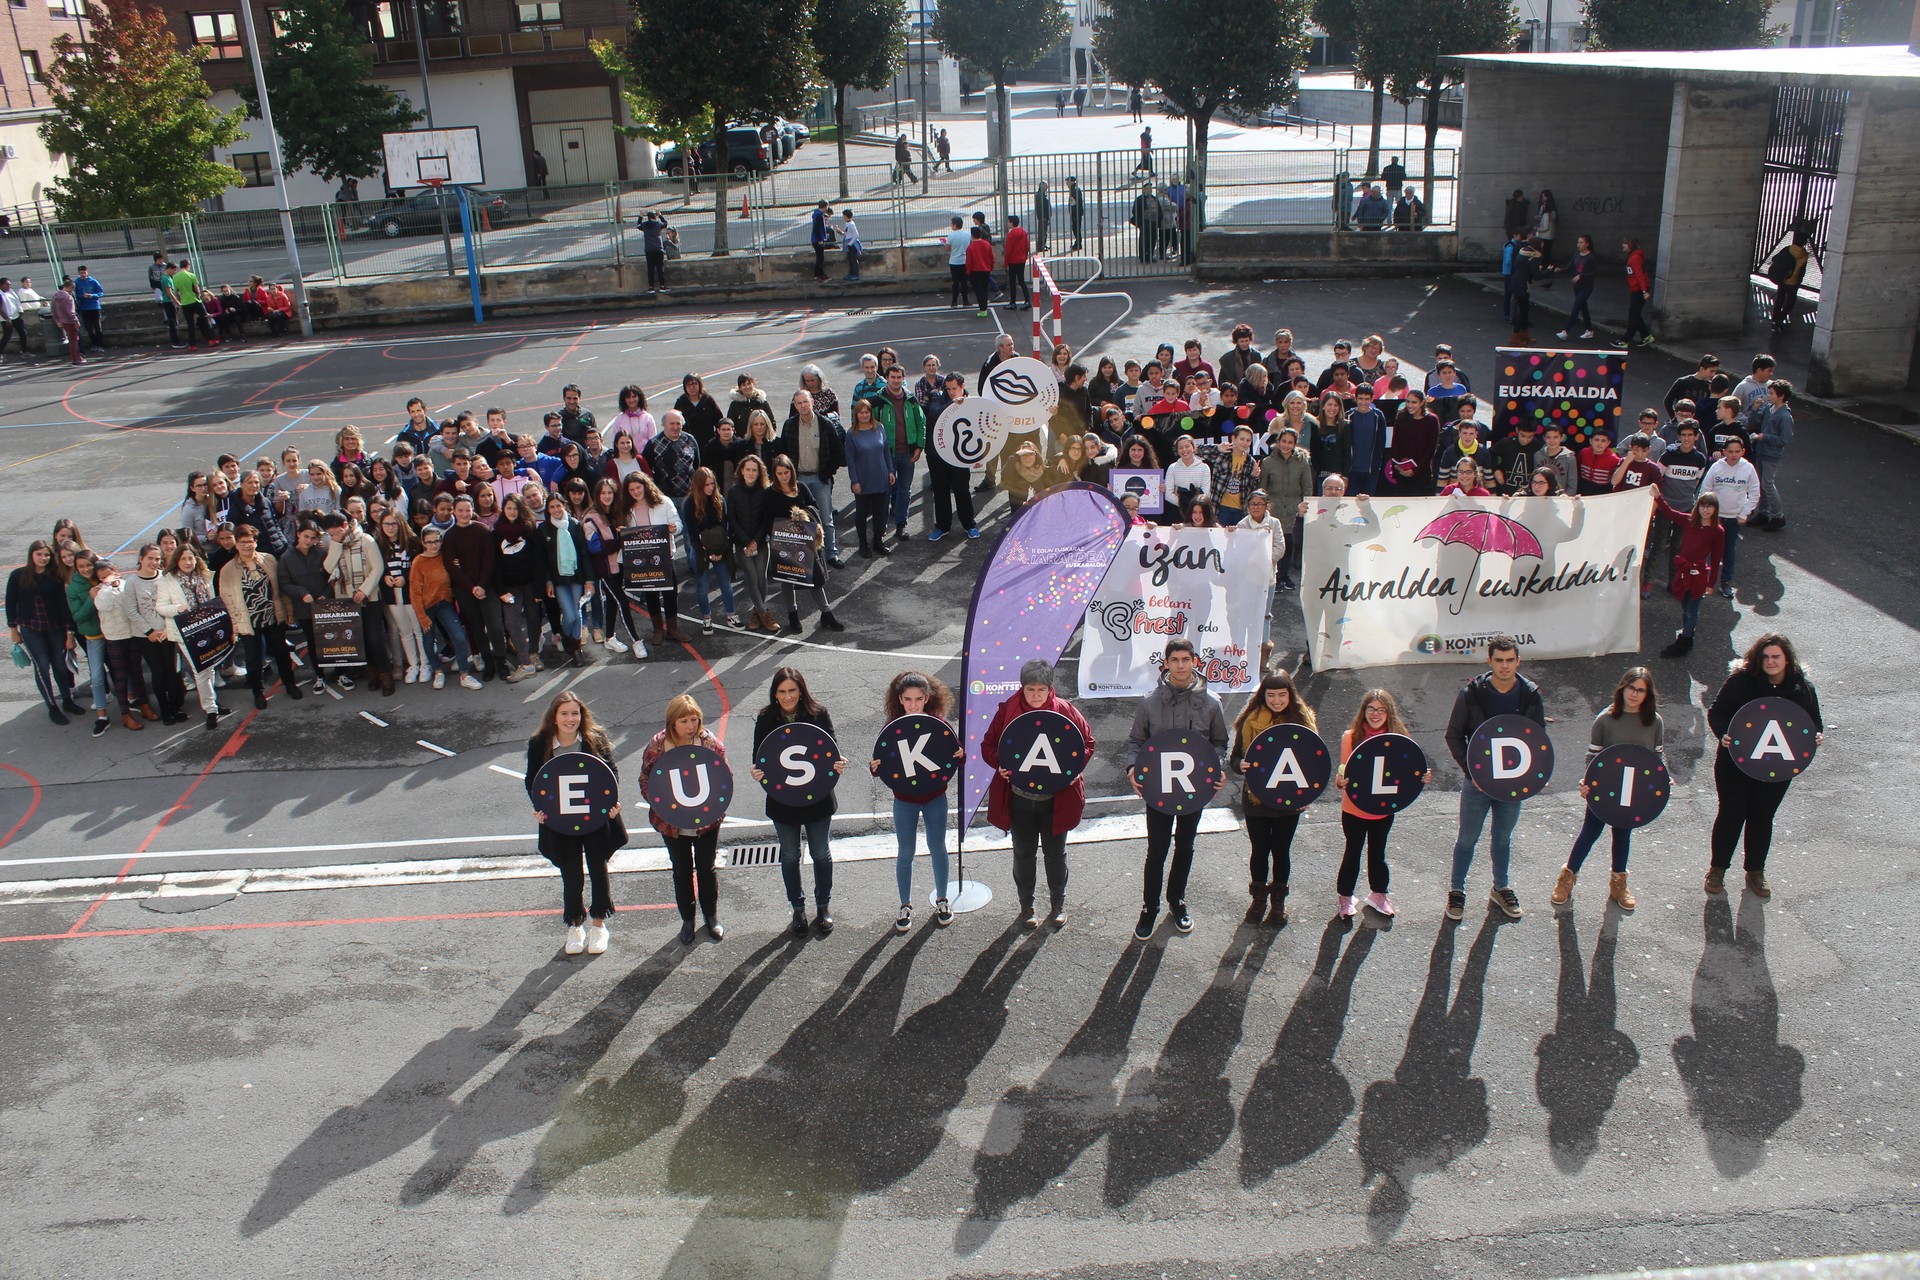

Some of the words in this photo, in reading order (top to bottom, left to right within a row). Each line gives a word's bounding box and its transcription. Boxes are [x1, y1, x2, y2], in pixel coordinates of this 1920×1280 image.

[1498, 385, 1618, 400] EUSKARALDIA
[1013, 417, 1036, 426] BIZI
[1671, 468, 1698, 477] URBAN
[623, 538, 668, 546] EUSKARALDIA
[774, 531, 814, 541] EUSKARALDIA
[1139, 531, 1225, 587] izan
[1319, 566, 1458, 604] Aiaraldea
[1479, 547, 1634, 598] euskaldun!
[181, 610, 228, 633] EUSKARALDIA
[314, 611, 360, 619] EUSKARALDIA
[1197, 620, 1219, 633] edo
[1223, 643, 1246, 657] Aho
[1445, 634, 1536, 650] KONTSUA
[897, 732, 941, 778] K
[1018, 732, 1063, 774] A
[1490, 736, 1532, 780] D
[1749, 719, 1796, 761] A
[669, 763, 711, 807] U
[778, 745, 816, 787] S
[1160, 751, 1197, 794] R
[1265, 747, 1309, 789] A
[1371, 755, 1399, 795] L
[1619, 766, 1636, 807] I
[558, 774, 591, 815] E
